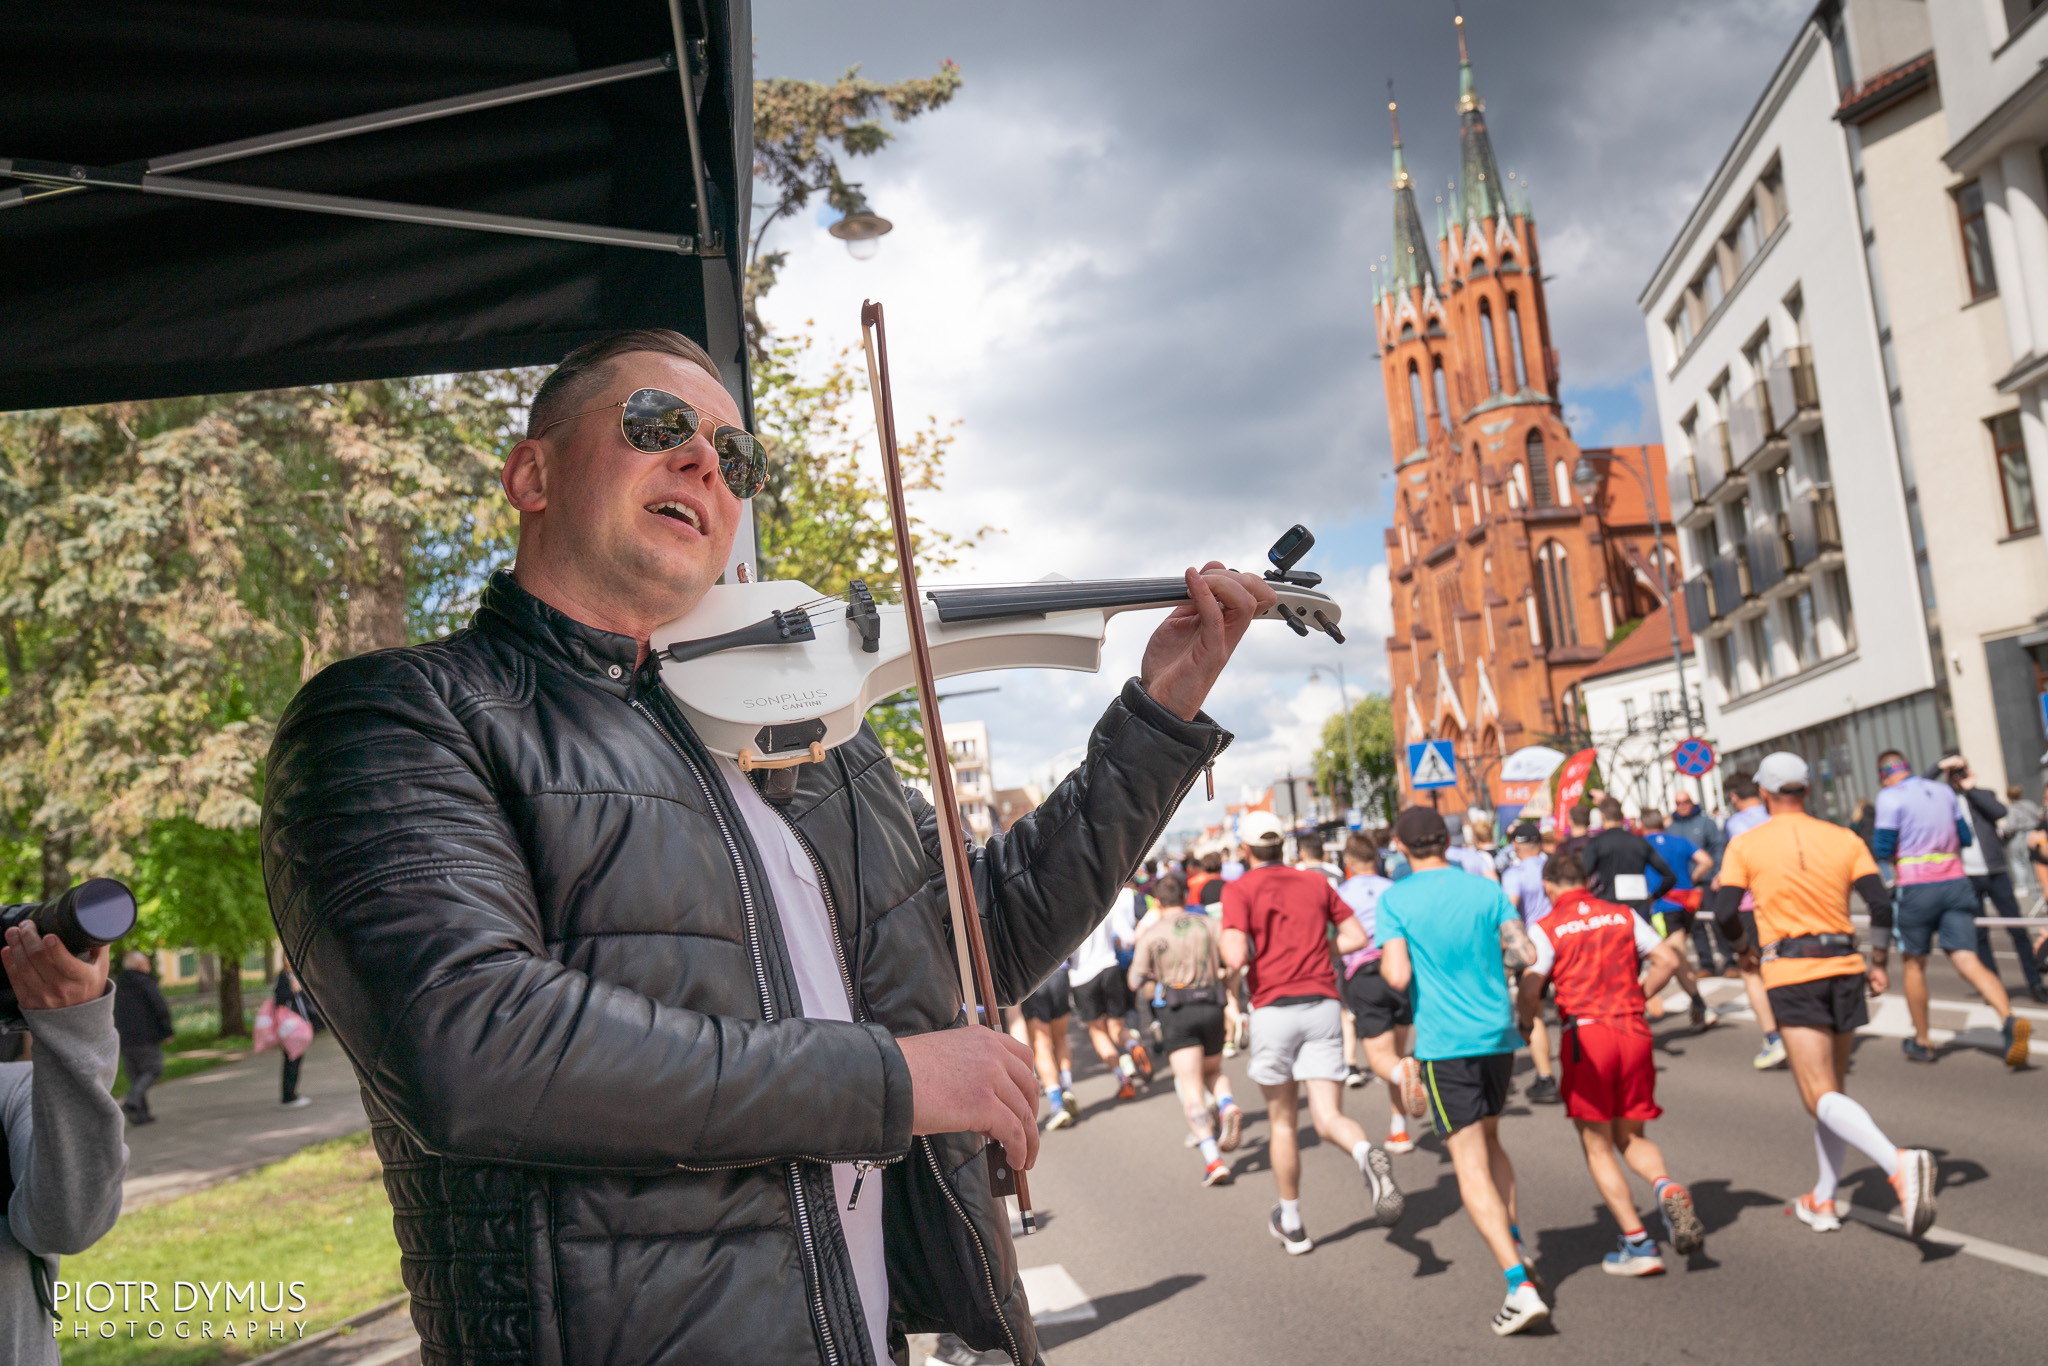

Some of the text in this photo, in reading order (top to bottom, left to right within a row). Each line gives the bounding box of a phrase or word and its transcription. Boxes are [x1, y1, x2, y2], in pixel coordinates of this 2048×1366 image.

[743, 689, 828, 708] SONPLUS
[782, 700, 822, 711] CANTINI
[1554, 913, 1627, 939] POLSKA
